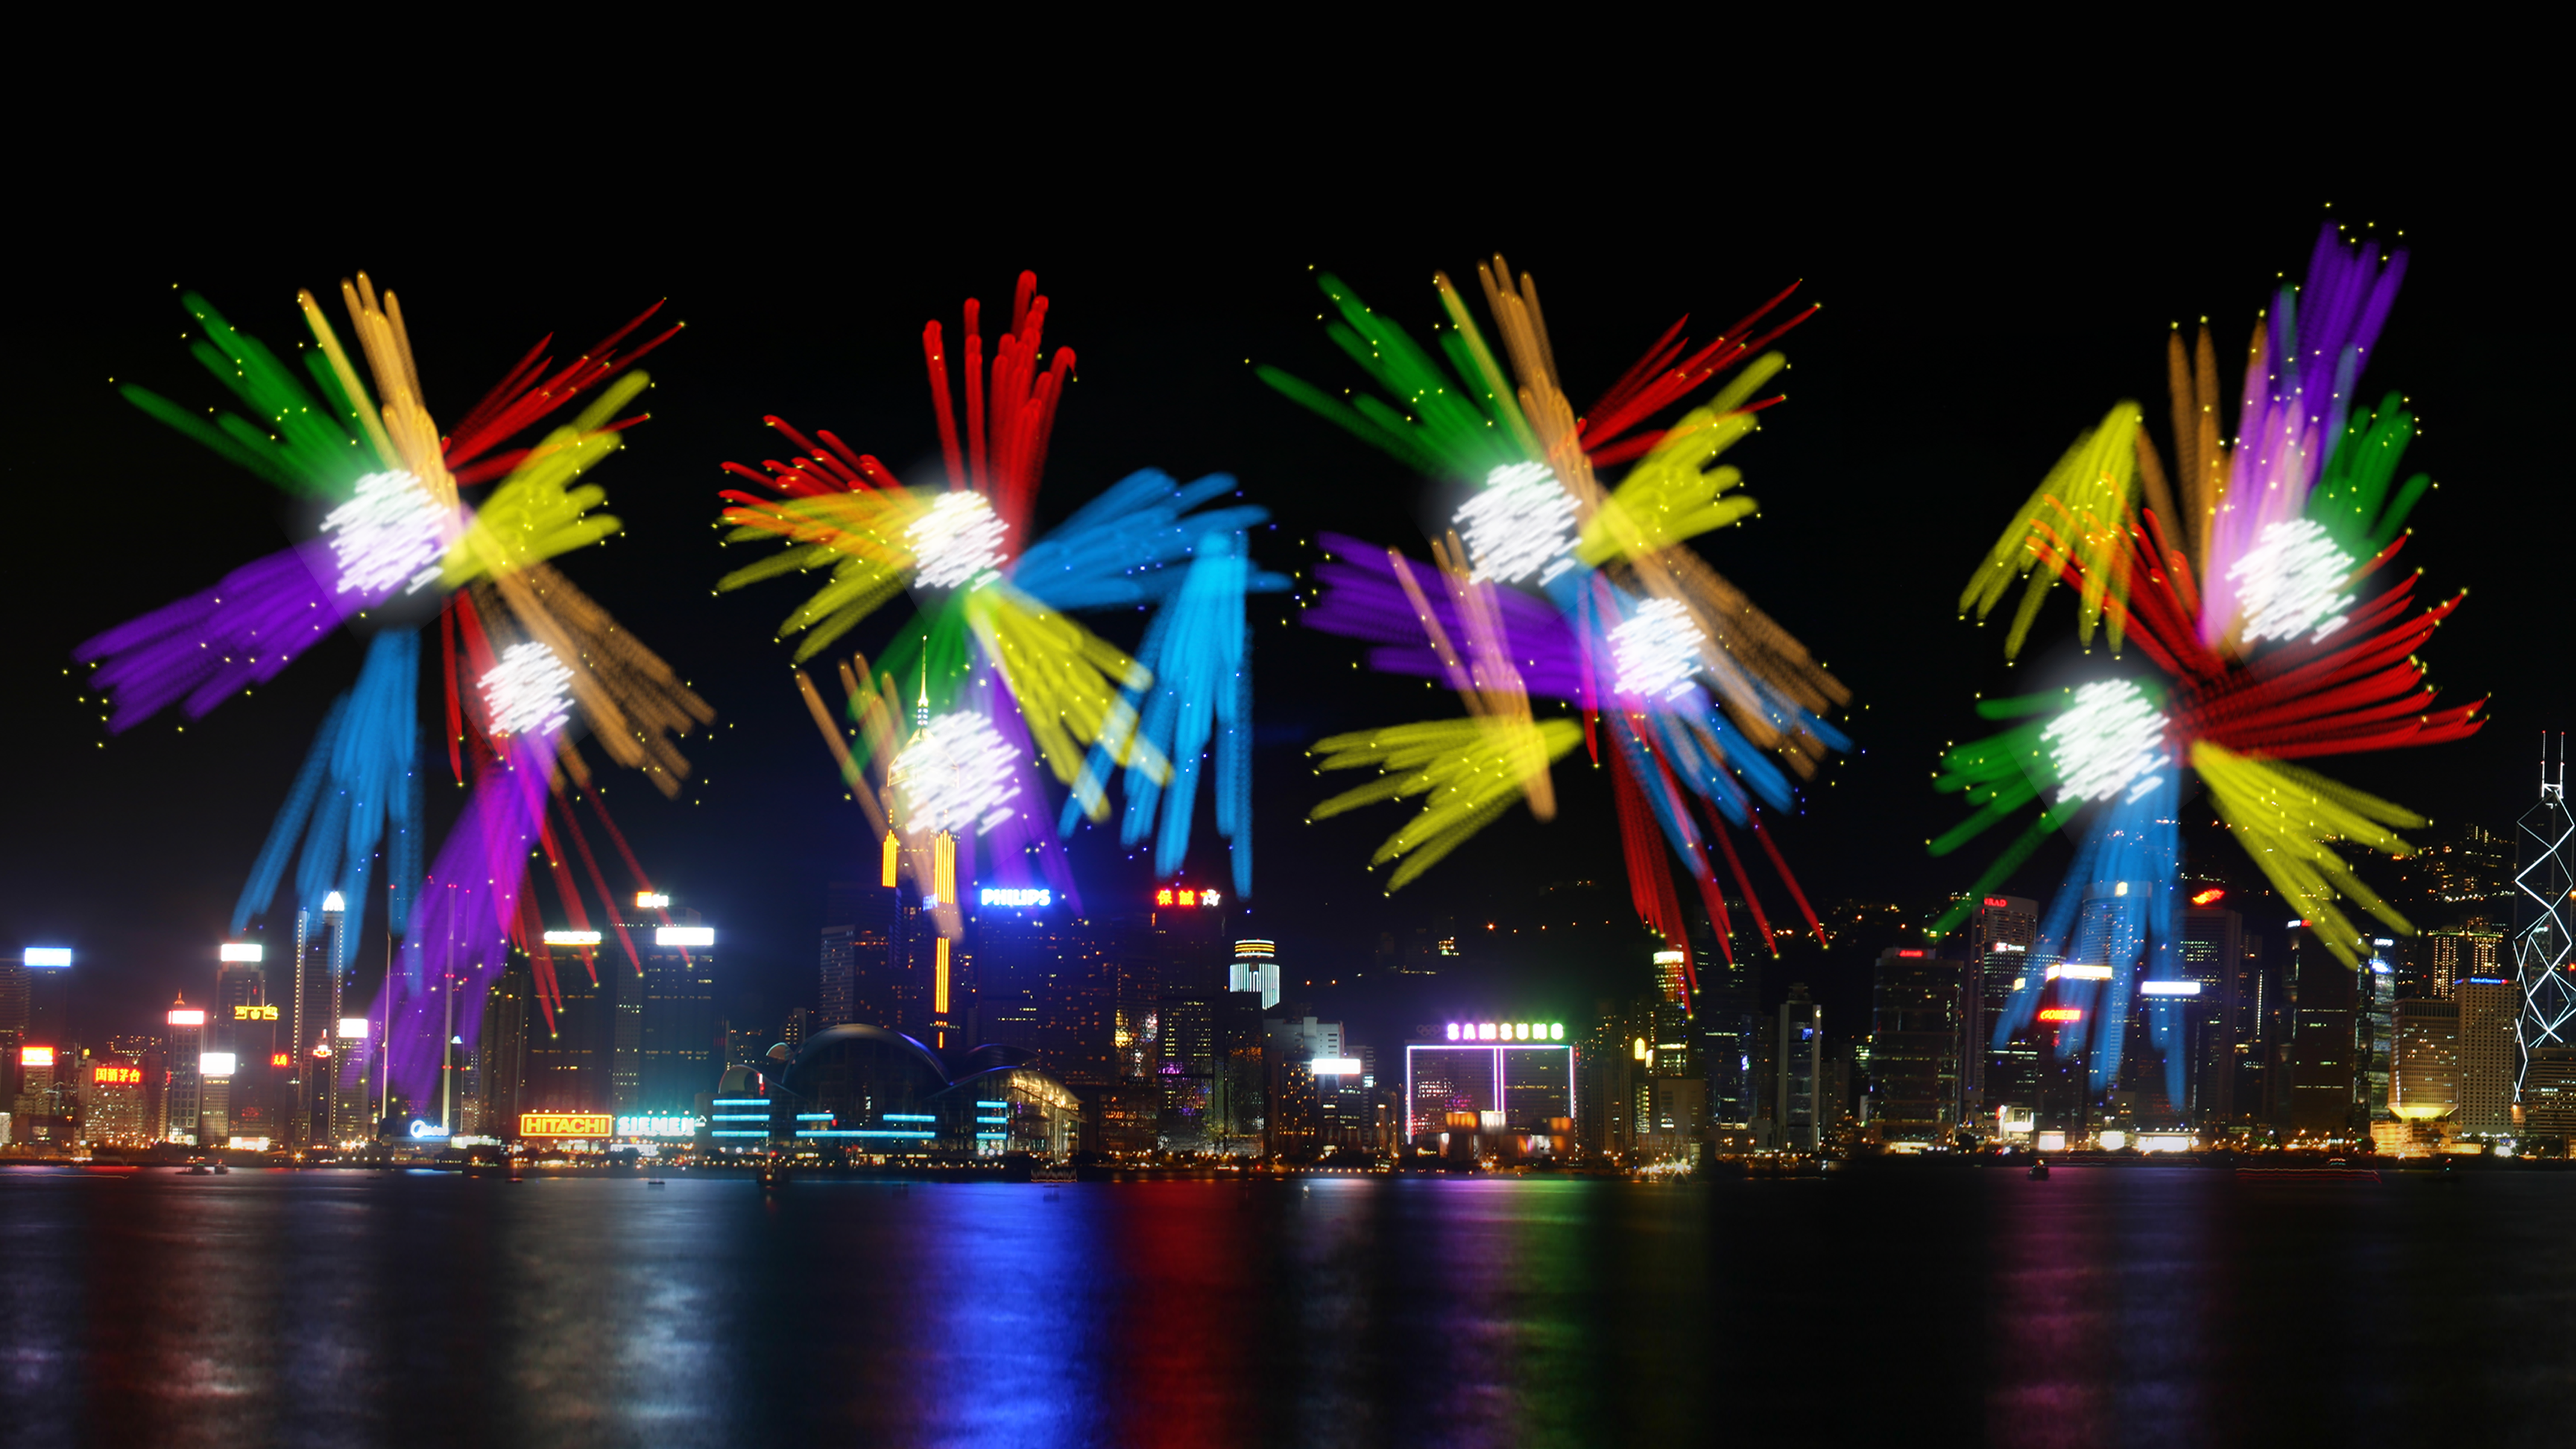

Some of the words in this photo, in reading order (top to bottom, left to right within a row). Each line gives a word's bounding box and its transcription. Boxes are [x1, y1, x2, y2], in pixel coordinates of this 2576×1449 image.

[981, 889, 1051, 906] PHILIPS
[1447, 1023, 1564, 1040] SAMSUNG
[95, 1068, 141, 1082] 国酒茅台
[526, 1118, 607, 1133] HITACHI
